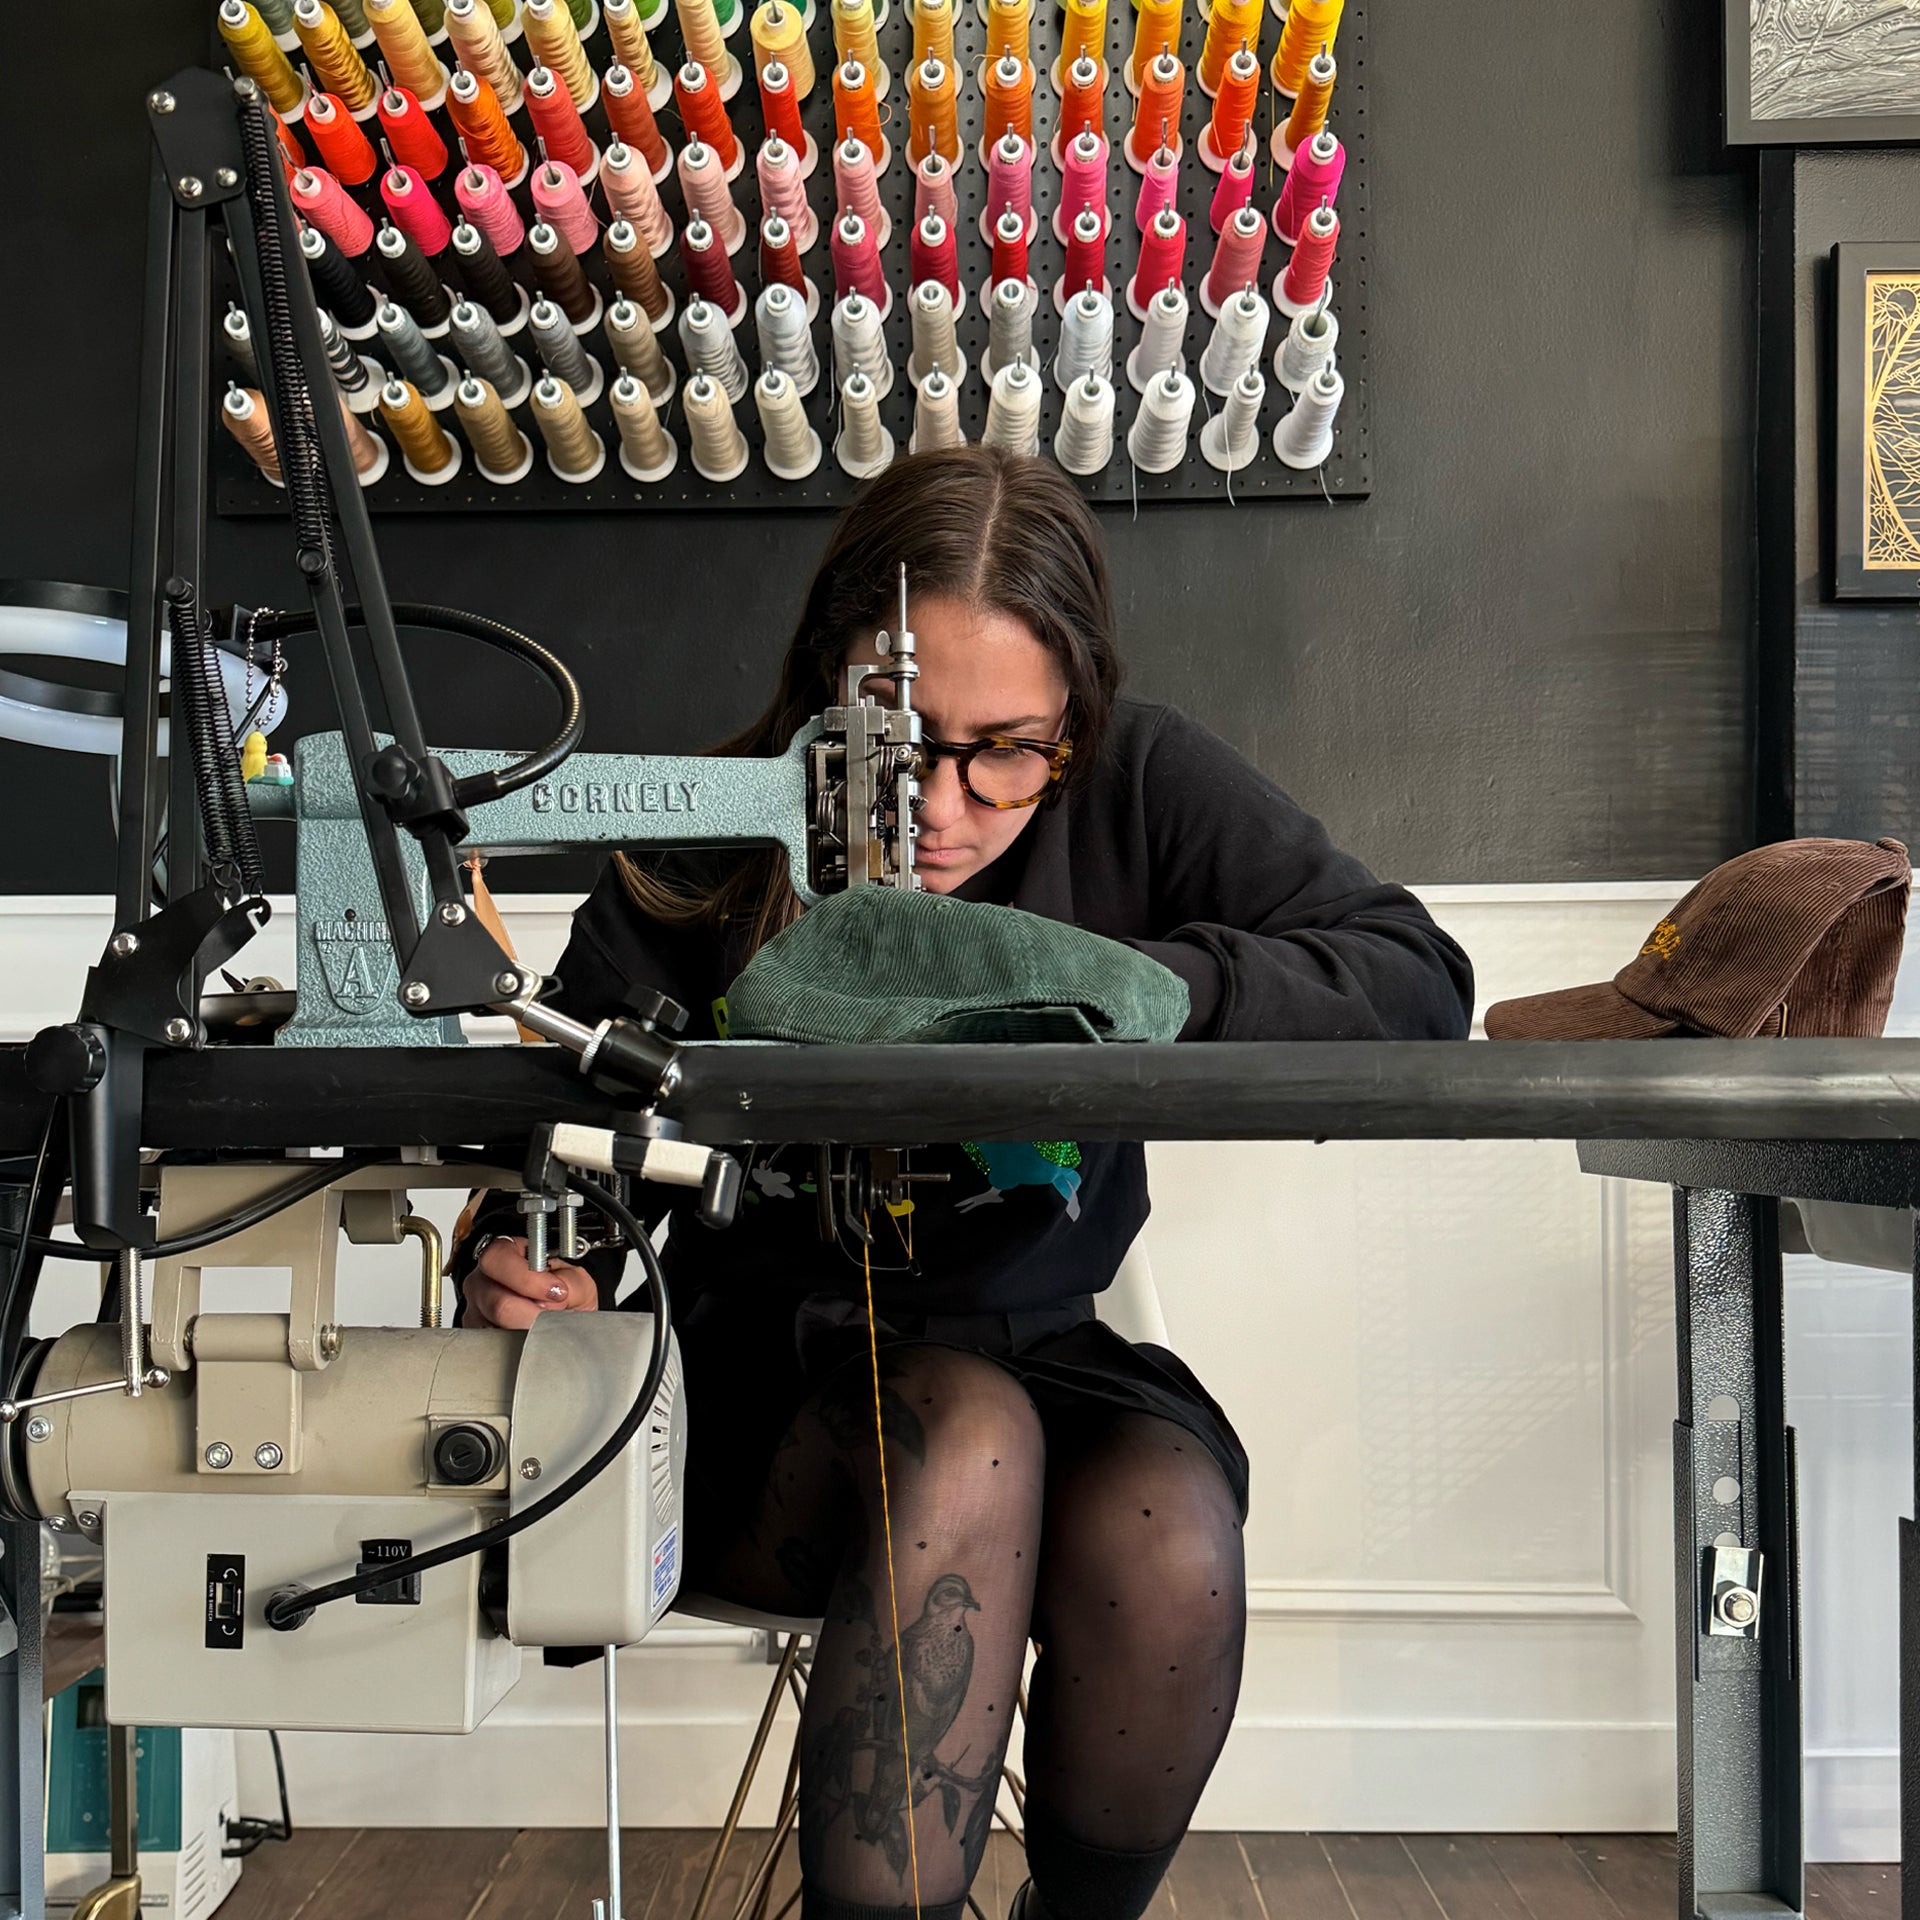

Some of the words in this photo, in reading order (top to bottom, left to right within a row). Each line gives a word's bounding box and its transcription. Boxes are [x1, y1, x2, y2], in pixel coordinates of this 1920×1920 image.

[532, 782, 701, 813] CORNELY
[315, 921, 391, 941] MACHIN
[334, 946, 380, 999] A
